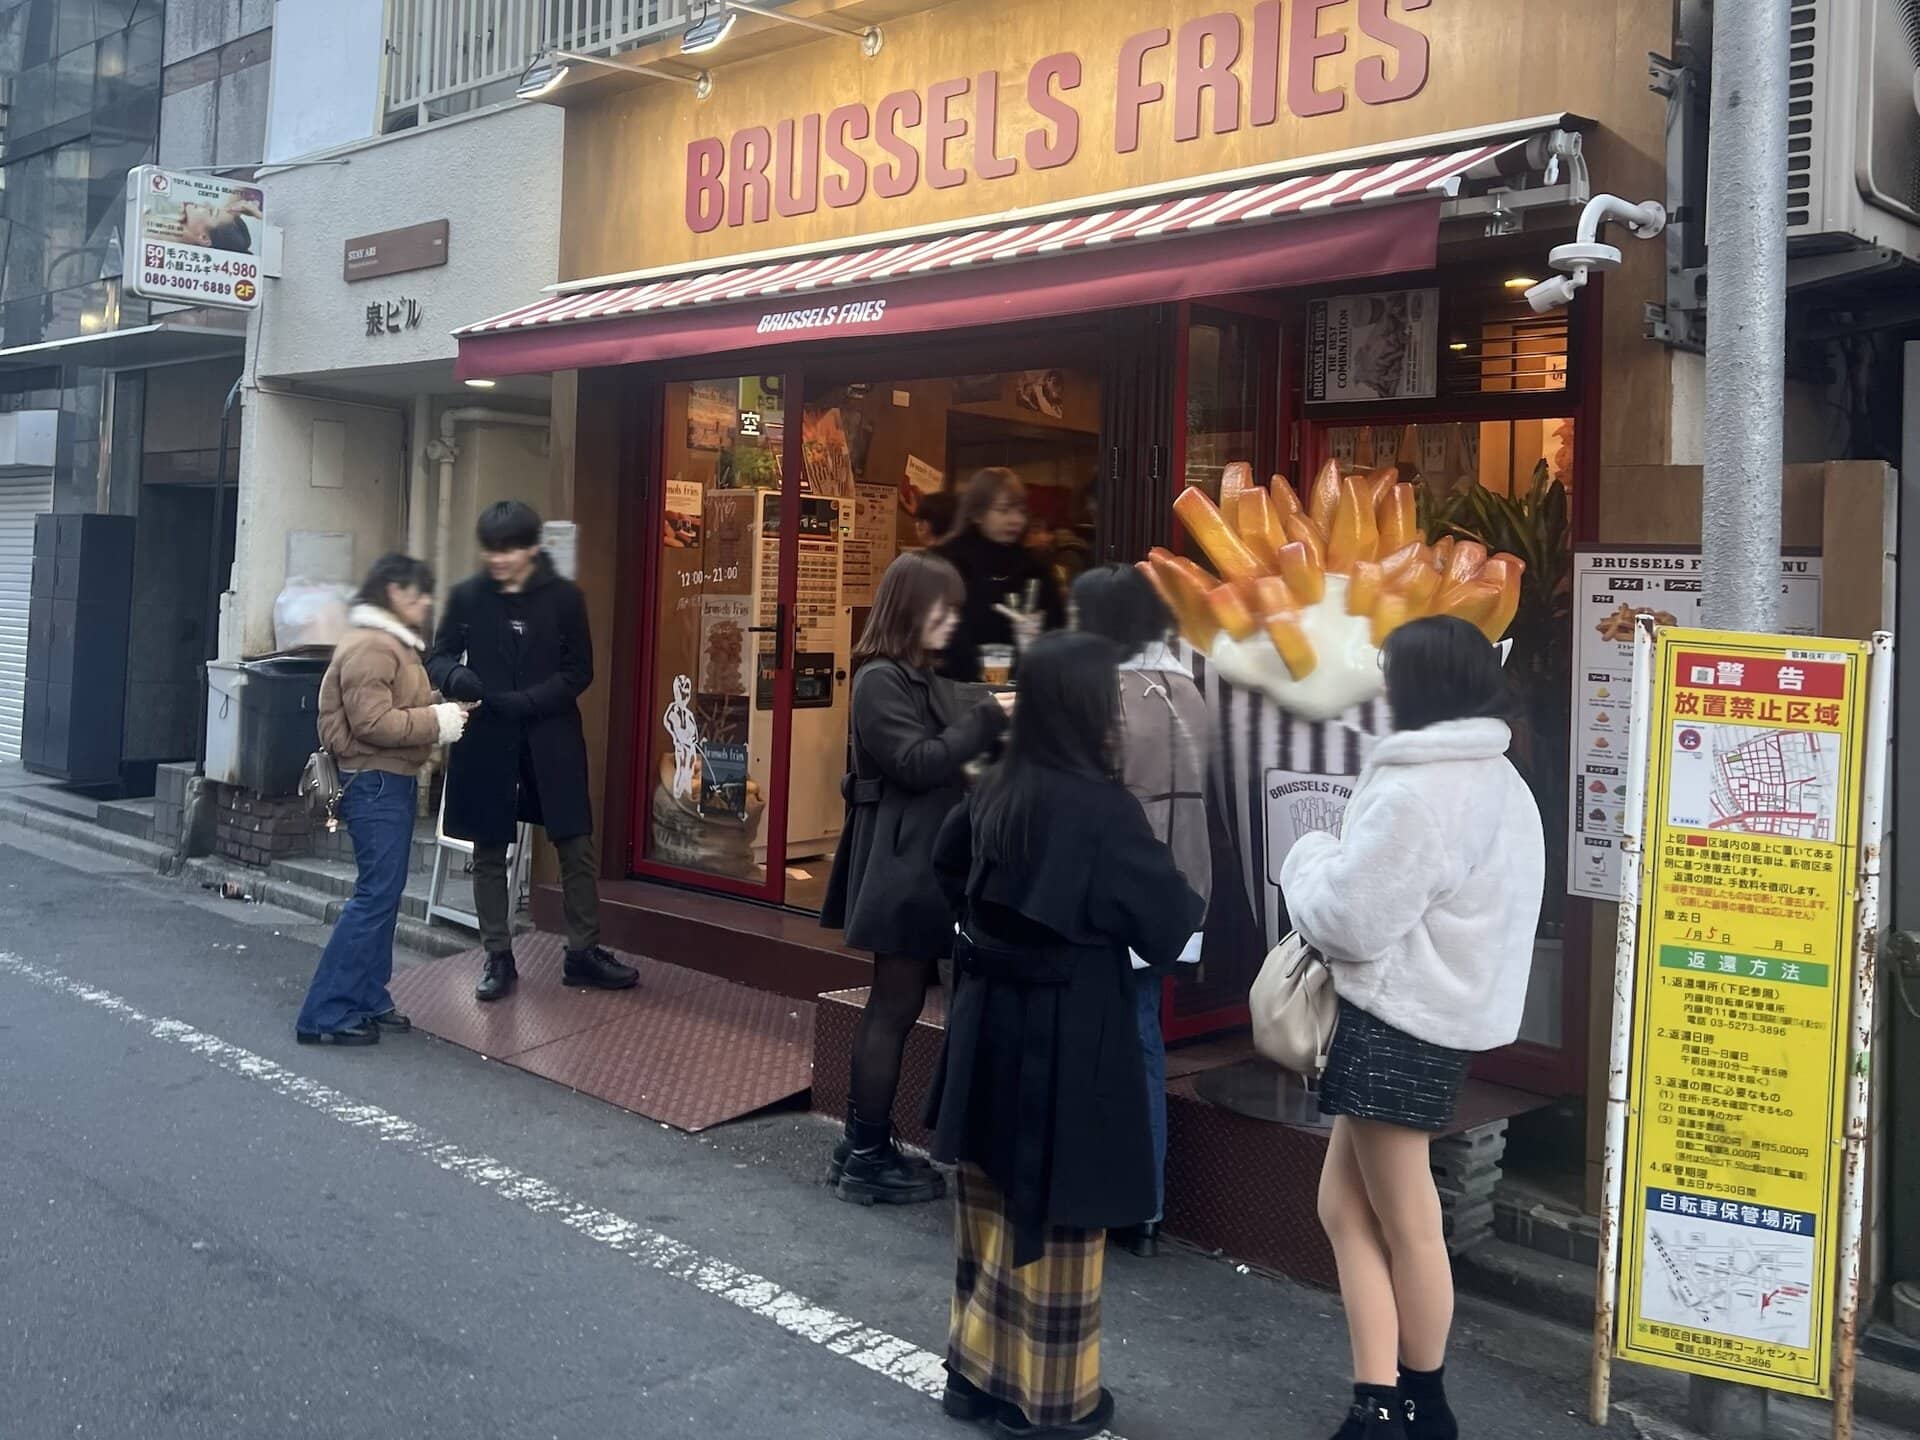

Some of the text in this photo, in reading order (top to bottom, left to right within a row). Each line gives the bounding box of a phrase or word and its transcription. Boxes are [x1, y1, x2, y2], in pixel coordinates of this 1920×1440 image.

[685, 0, 1431, 233] BRUSSELS FRIES
[147, 246, 163, 257] 50
[167, 248, 212, 263] 毛穴洗浄
[147, 258, 161, 268] 分
[214, 260, 257, 279] ¥4,980
[145, 272, 254, 297] 080-3007-6889 2F
[366, 296, 423, 336] 泉ビル
[757, 300, 886, 333] BRUSSELS FRIES
[1337, 309, 1349, 389] COMBINATION
[1313, 343, 1325, 397] BRUSSELS
[1328, 353, 1337, 373] THE
[1592, 557, 1685, 570] BRUSSELS
[1674, 692, 1840, 726] 放置禁止区域
[1270, 781, 1353, 799] BRUSSELS FRI
[1664, 909, 1701, 923] 撤去日
[1710, 1019, 1786, 1036] 03-5273-3896
[1660, 1192, 1803, 1232] 自転車保管場所
[1697, 1347, 1771, 1369] 03-5273-3896
